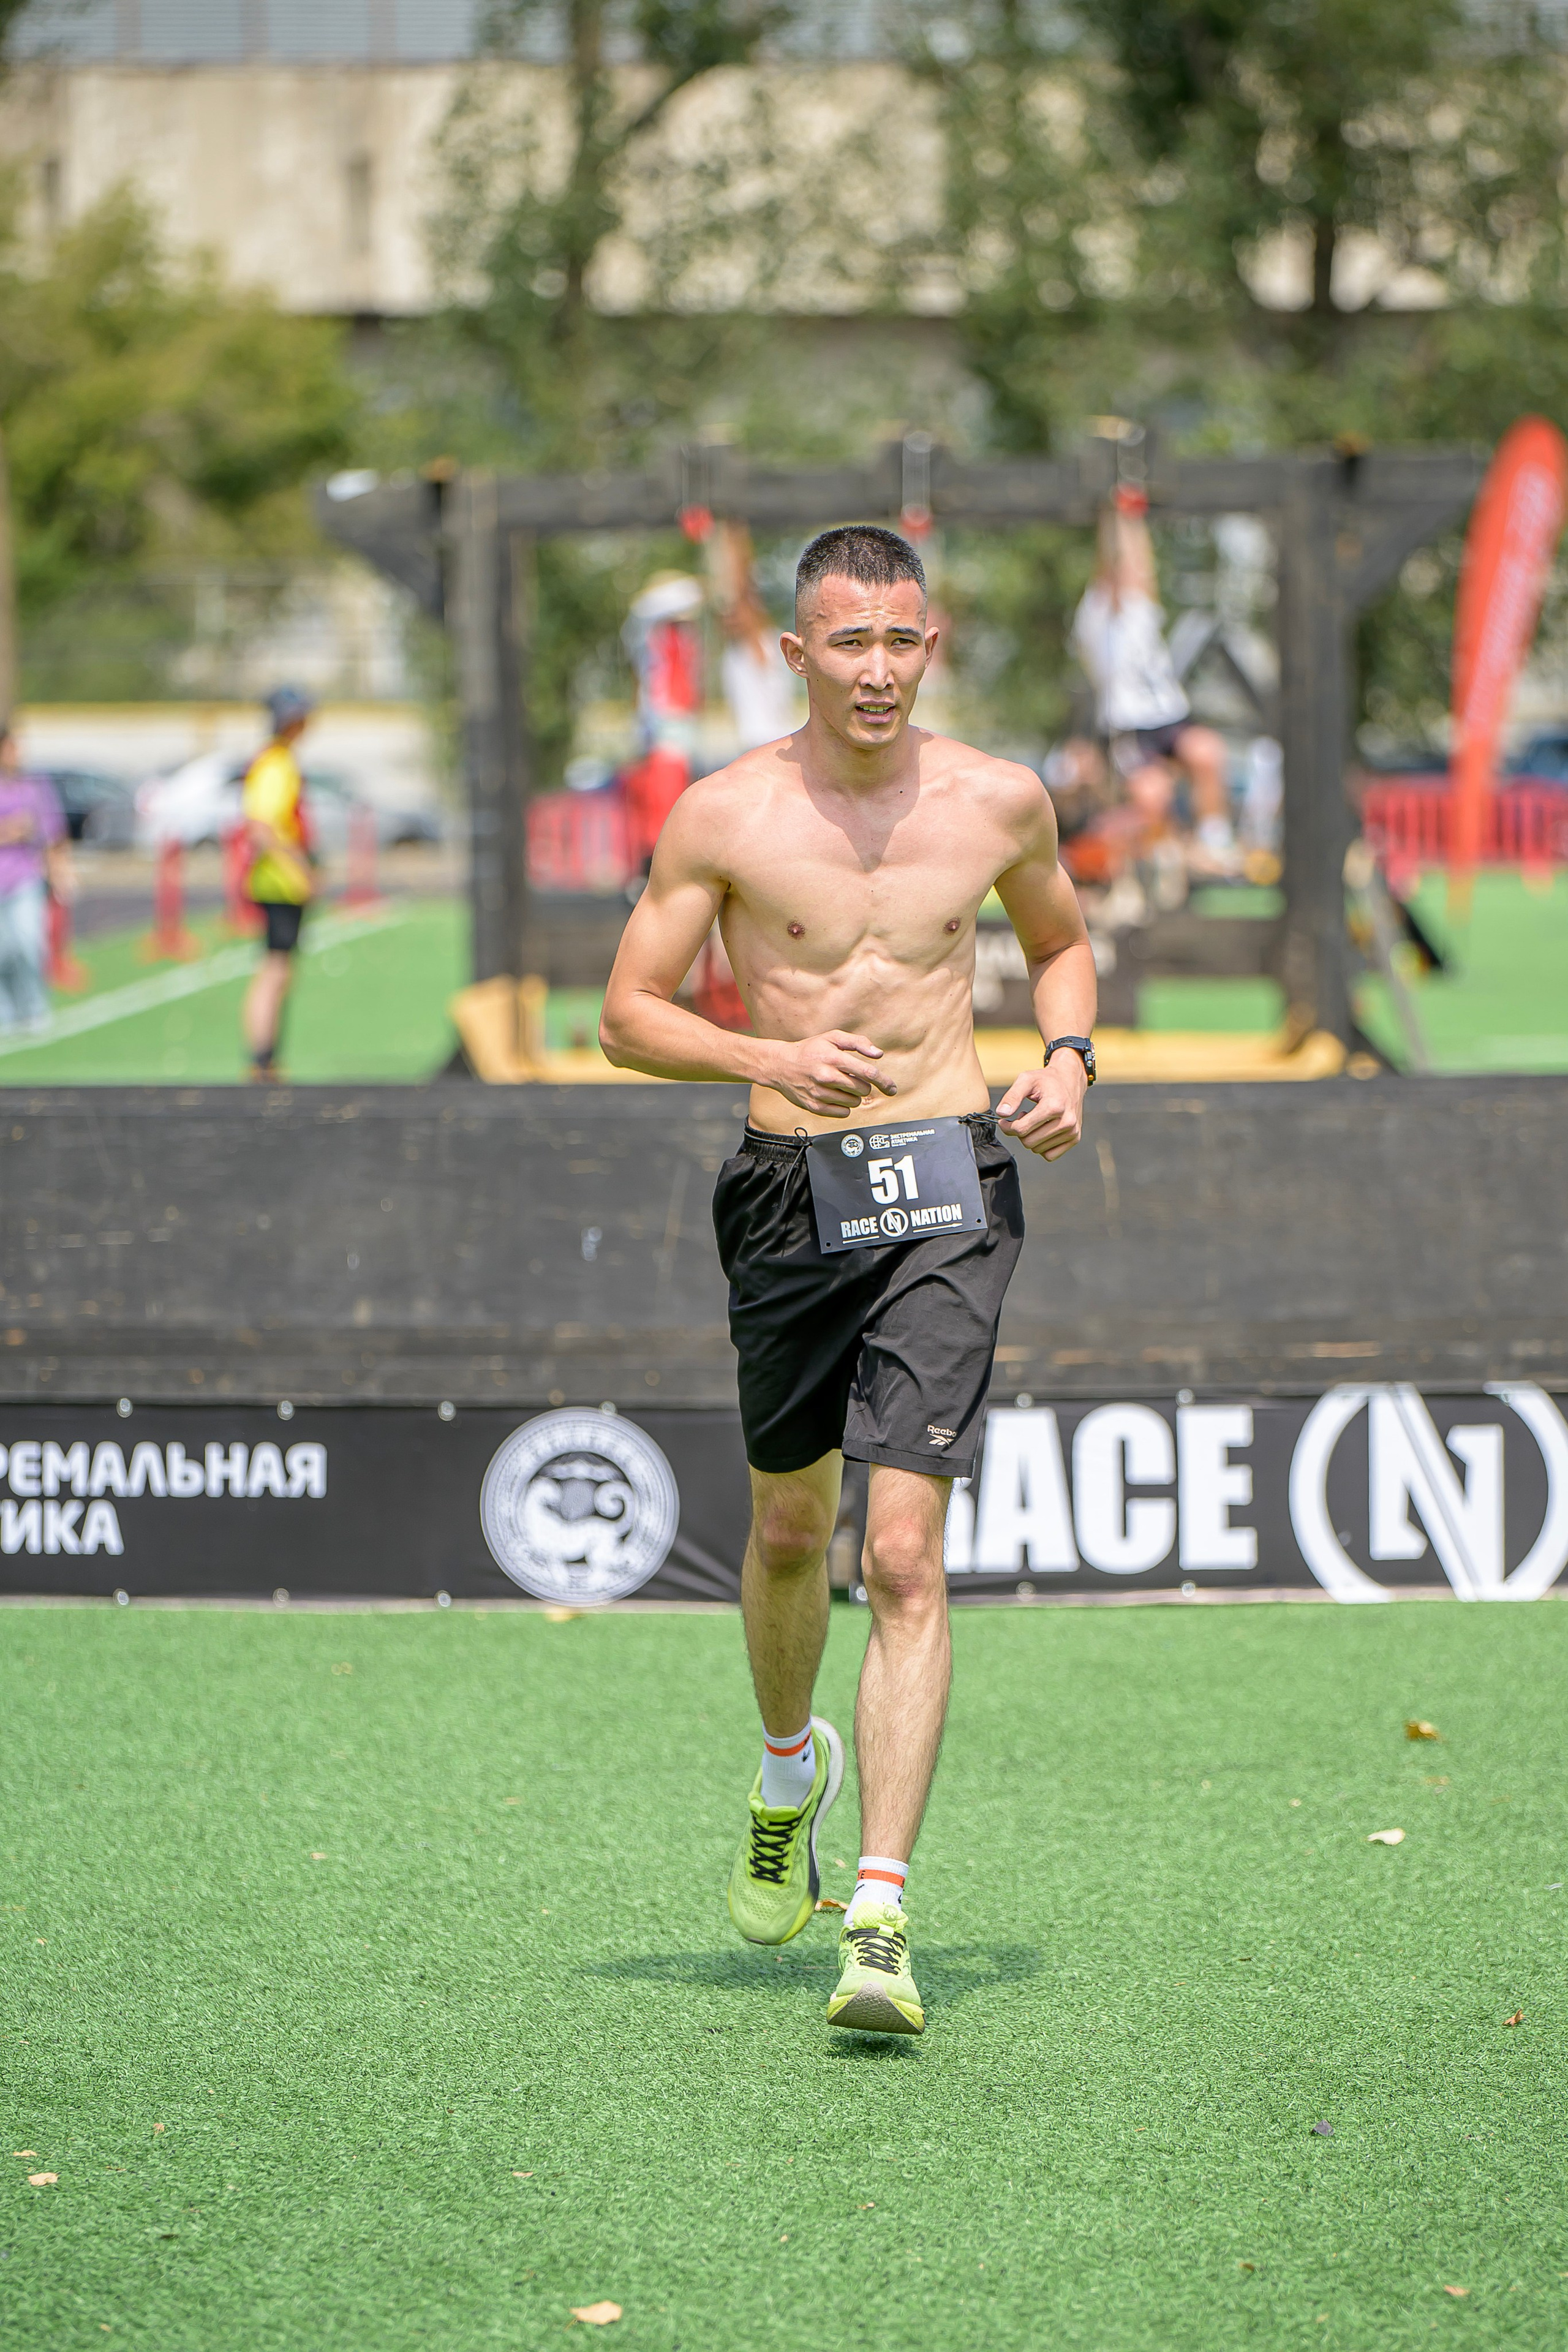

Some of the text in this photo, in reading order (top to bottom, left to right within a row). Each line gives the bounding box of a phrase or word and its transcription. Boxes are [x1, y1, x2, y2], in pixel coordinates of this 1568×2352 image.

[867, 1155, 919, 1205] 51
[840, 1216, 879, 1238] RACE
[910, 1203, 963, 1227] NATION
[927, 1424, 958, 1438] Reebo
[0, 1441, 328, 1498] ЕМАЛЬНАЯ
[0, 1499, 125, 1556] ИКА
